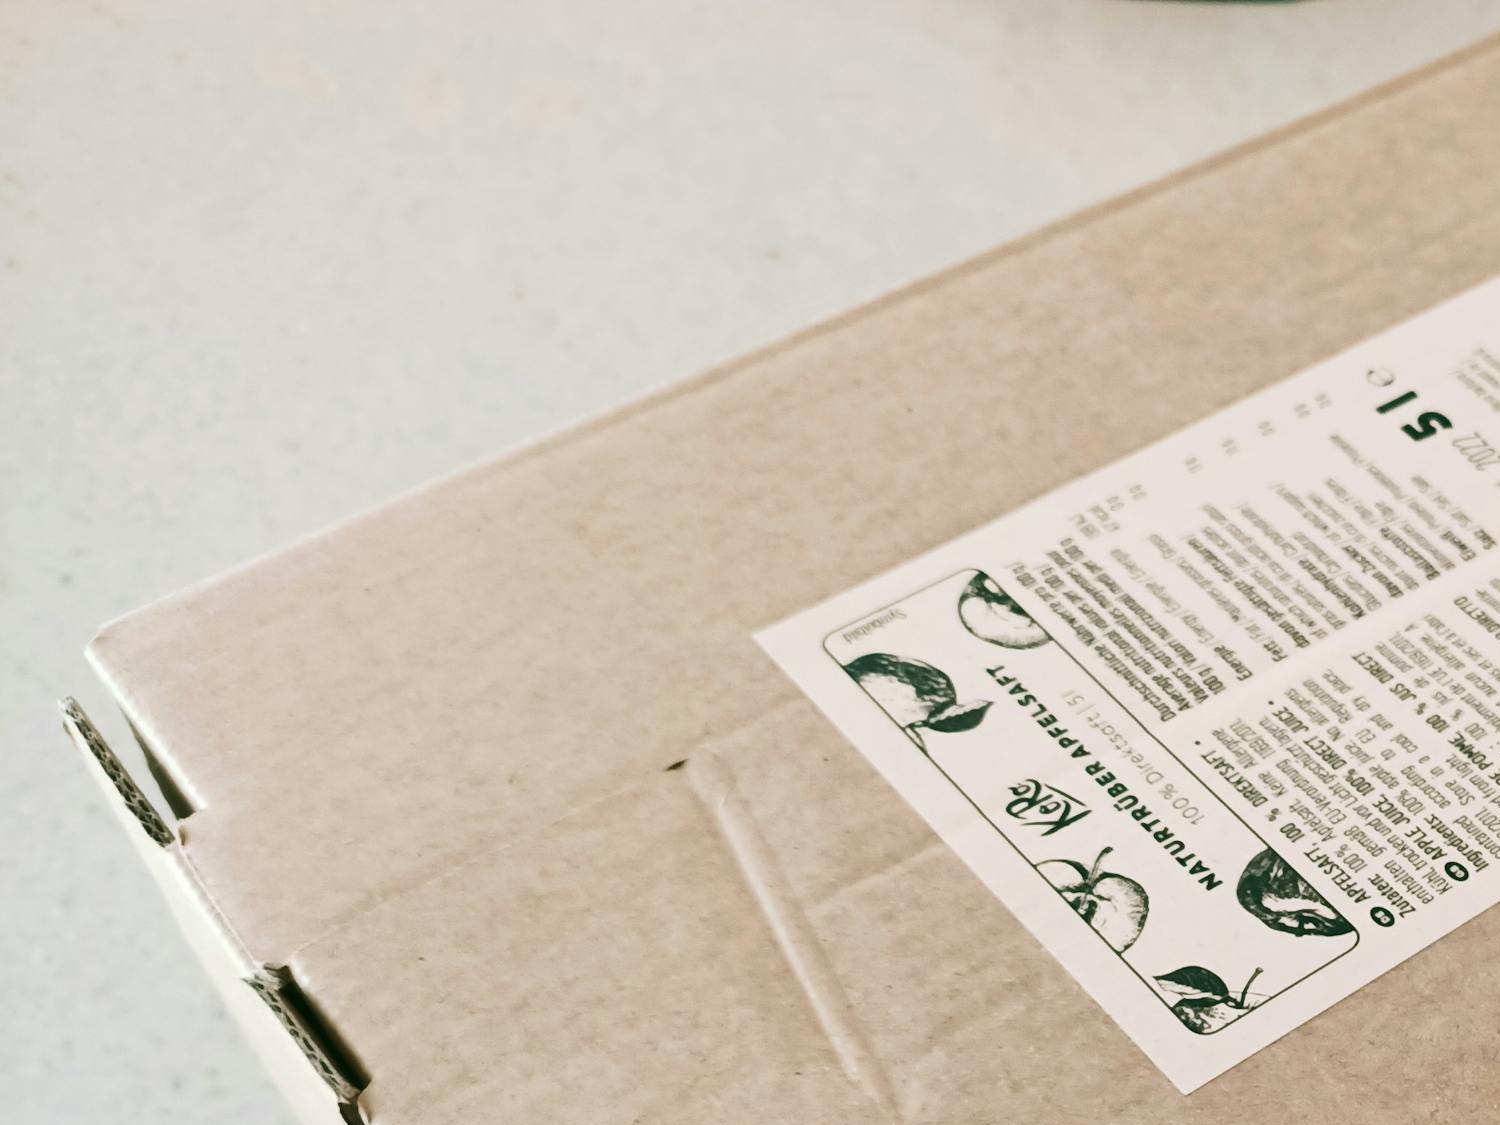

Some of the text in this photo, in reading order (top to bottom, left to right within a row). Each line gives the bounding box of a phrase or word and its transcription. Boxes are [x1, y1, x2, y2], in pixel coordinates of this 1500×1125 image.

[1399, 410, 1453, 442] 5
[1102, 628, 1156, 676] nutritional
[1166, 638, 1197, 667] Valori
[1261, 639, 1289, 663] Fett
[1449, 636, 1467, 649] et
[1461, 645, 1483, 662] sec
[1212, 643, 1254, 682] Energie
[1350, 651, 1395, 685] DIRECT
[1475, 658, 1494, 671] et
[1092, 643, 1177, 723] Durchschnittliche
[1150, 673, 1193, 712] Average
[1170, 666, 1209, 704] Valeurs
[1201, 674, 1225, 695] 100
[1388, 681, 1418, 702] JUS
[1412, 675, 1431, 689] de
[1448, 681, 1467, 696] de
[1463, 671, 1498, 698] aucun
[1283, 686, 1330, 727] allergens
[1301, 677, 1353, 725] Regulation
[1351, 694, 1372, 712] dry
[1430, 689, 1454, 706] jus
[1325, 725, 1342, 743] No
[1354, 727, 1377, 745] EU
[1367, 712, 1394, 732] and
[1424, 713, 1450, 734] 100
[1085, 711, 1165, 786] Direktsaft
[1210, 727, 1258, 770] Allergene
[1379, 747, 1397, 762] to
[1388, 732, 1419, 754] cool
[1284, 742, 1338, 785] geschützt
[1416, 754, 1431, 764] a
[1428, 764, 1445, 780] in
[984, 664, 1224, 892] NATURTRÜBER APFELSAFT
[1199, 749, 1269, 808] DIREKTSAFT
[1256, 770, 1288, 798] Keine
[1270, 705, 1448, 861] APPLE JUICE, 100% DIRECT JUICE
[1367, 763, 1400, 790] apple
[1399, 763, 1452, 809] according
[1467, 773, 1497, 800] from
[1274, 757, 1348, 826] EU-Verordnung
[1326, 780, 1359, 808] Licht
[1443, 778, 1476, 807] Store
[1004, 777, 1092, 837] KoRo
[1351, 803, 1374, 821] vor
[1341, 824, 1388, 858] gemäß
[1363, 816, 1393, 837] und
[1385, 833, 1428, 872] trocken
[1422, 812, 1490, 873] Ingredients:
[1302, 841, 1372, 904] APFELSAFT,
[1382, 858, 1435, 905] enthalten
[1366, 872, 1417, 919] Zutaten:
